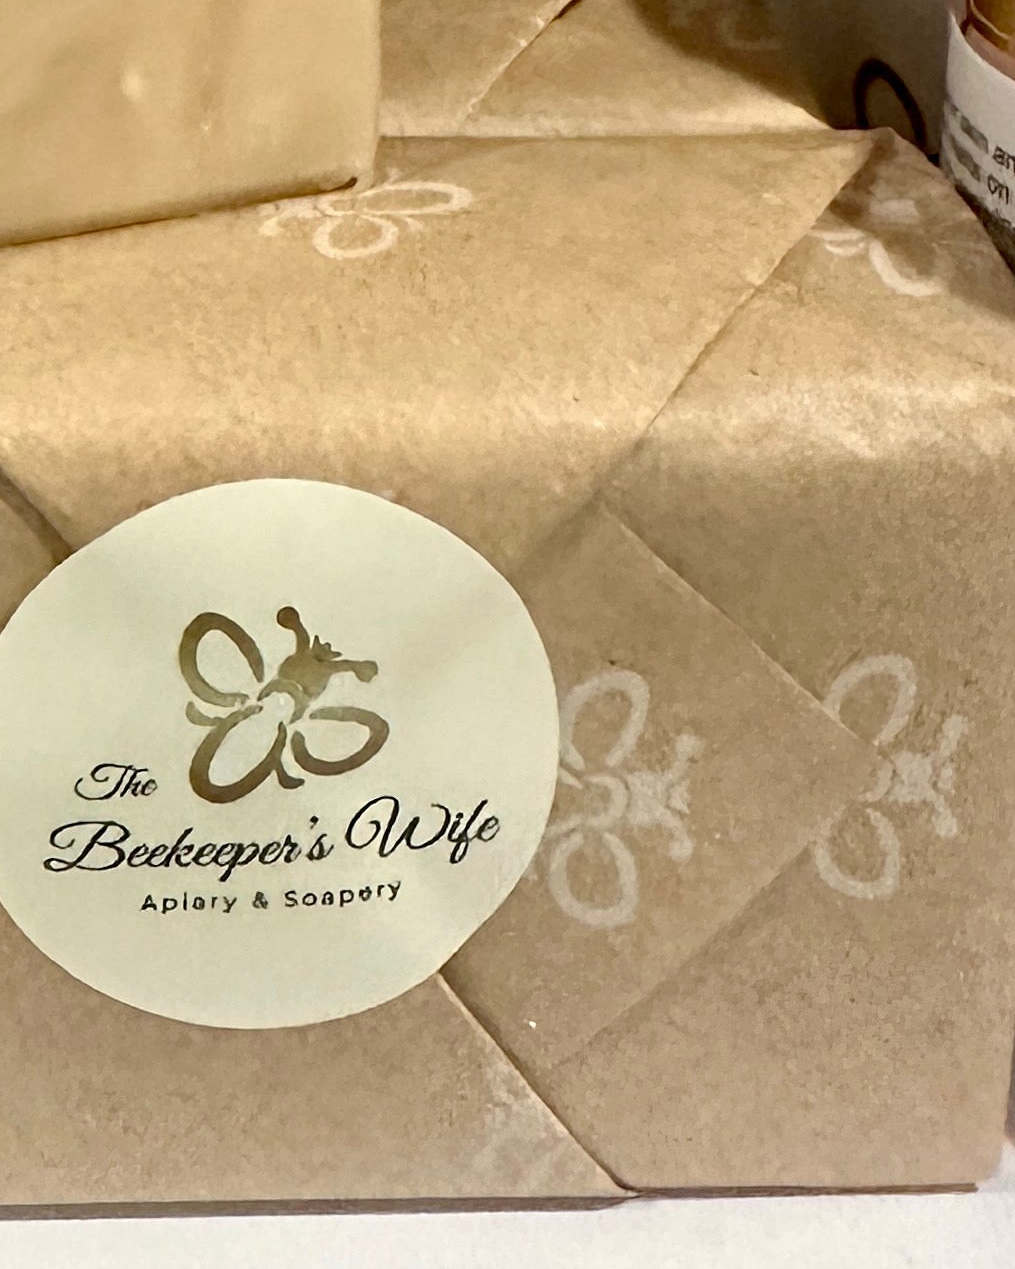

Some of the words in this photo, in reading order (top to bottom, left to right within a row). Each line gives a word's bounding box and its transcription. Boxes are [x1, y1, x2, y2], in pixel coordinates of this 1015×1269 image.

[74, 763, 158, 800] The
[43, 816, 334, 882] Beekeeper's
[345, 795, 501, 864] Wife
[252, 891, 268, 909] &
[284, 881, 401, 908] Soapery
